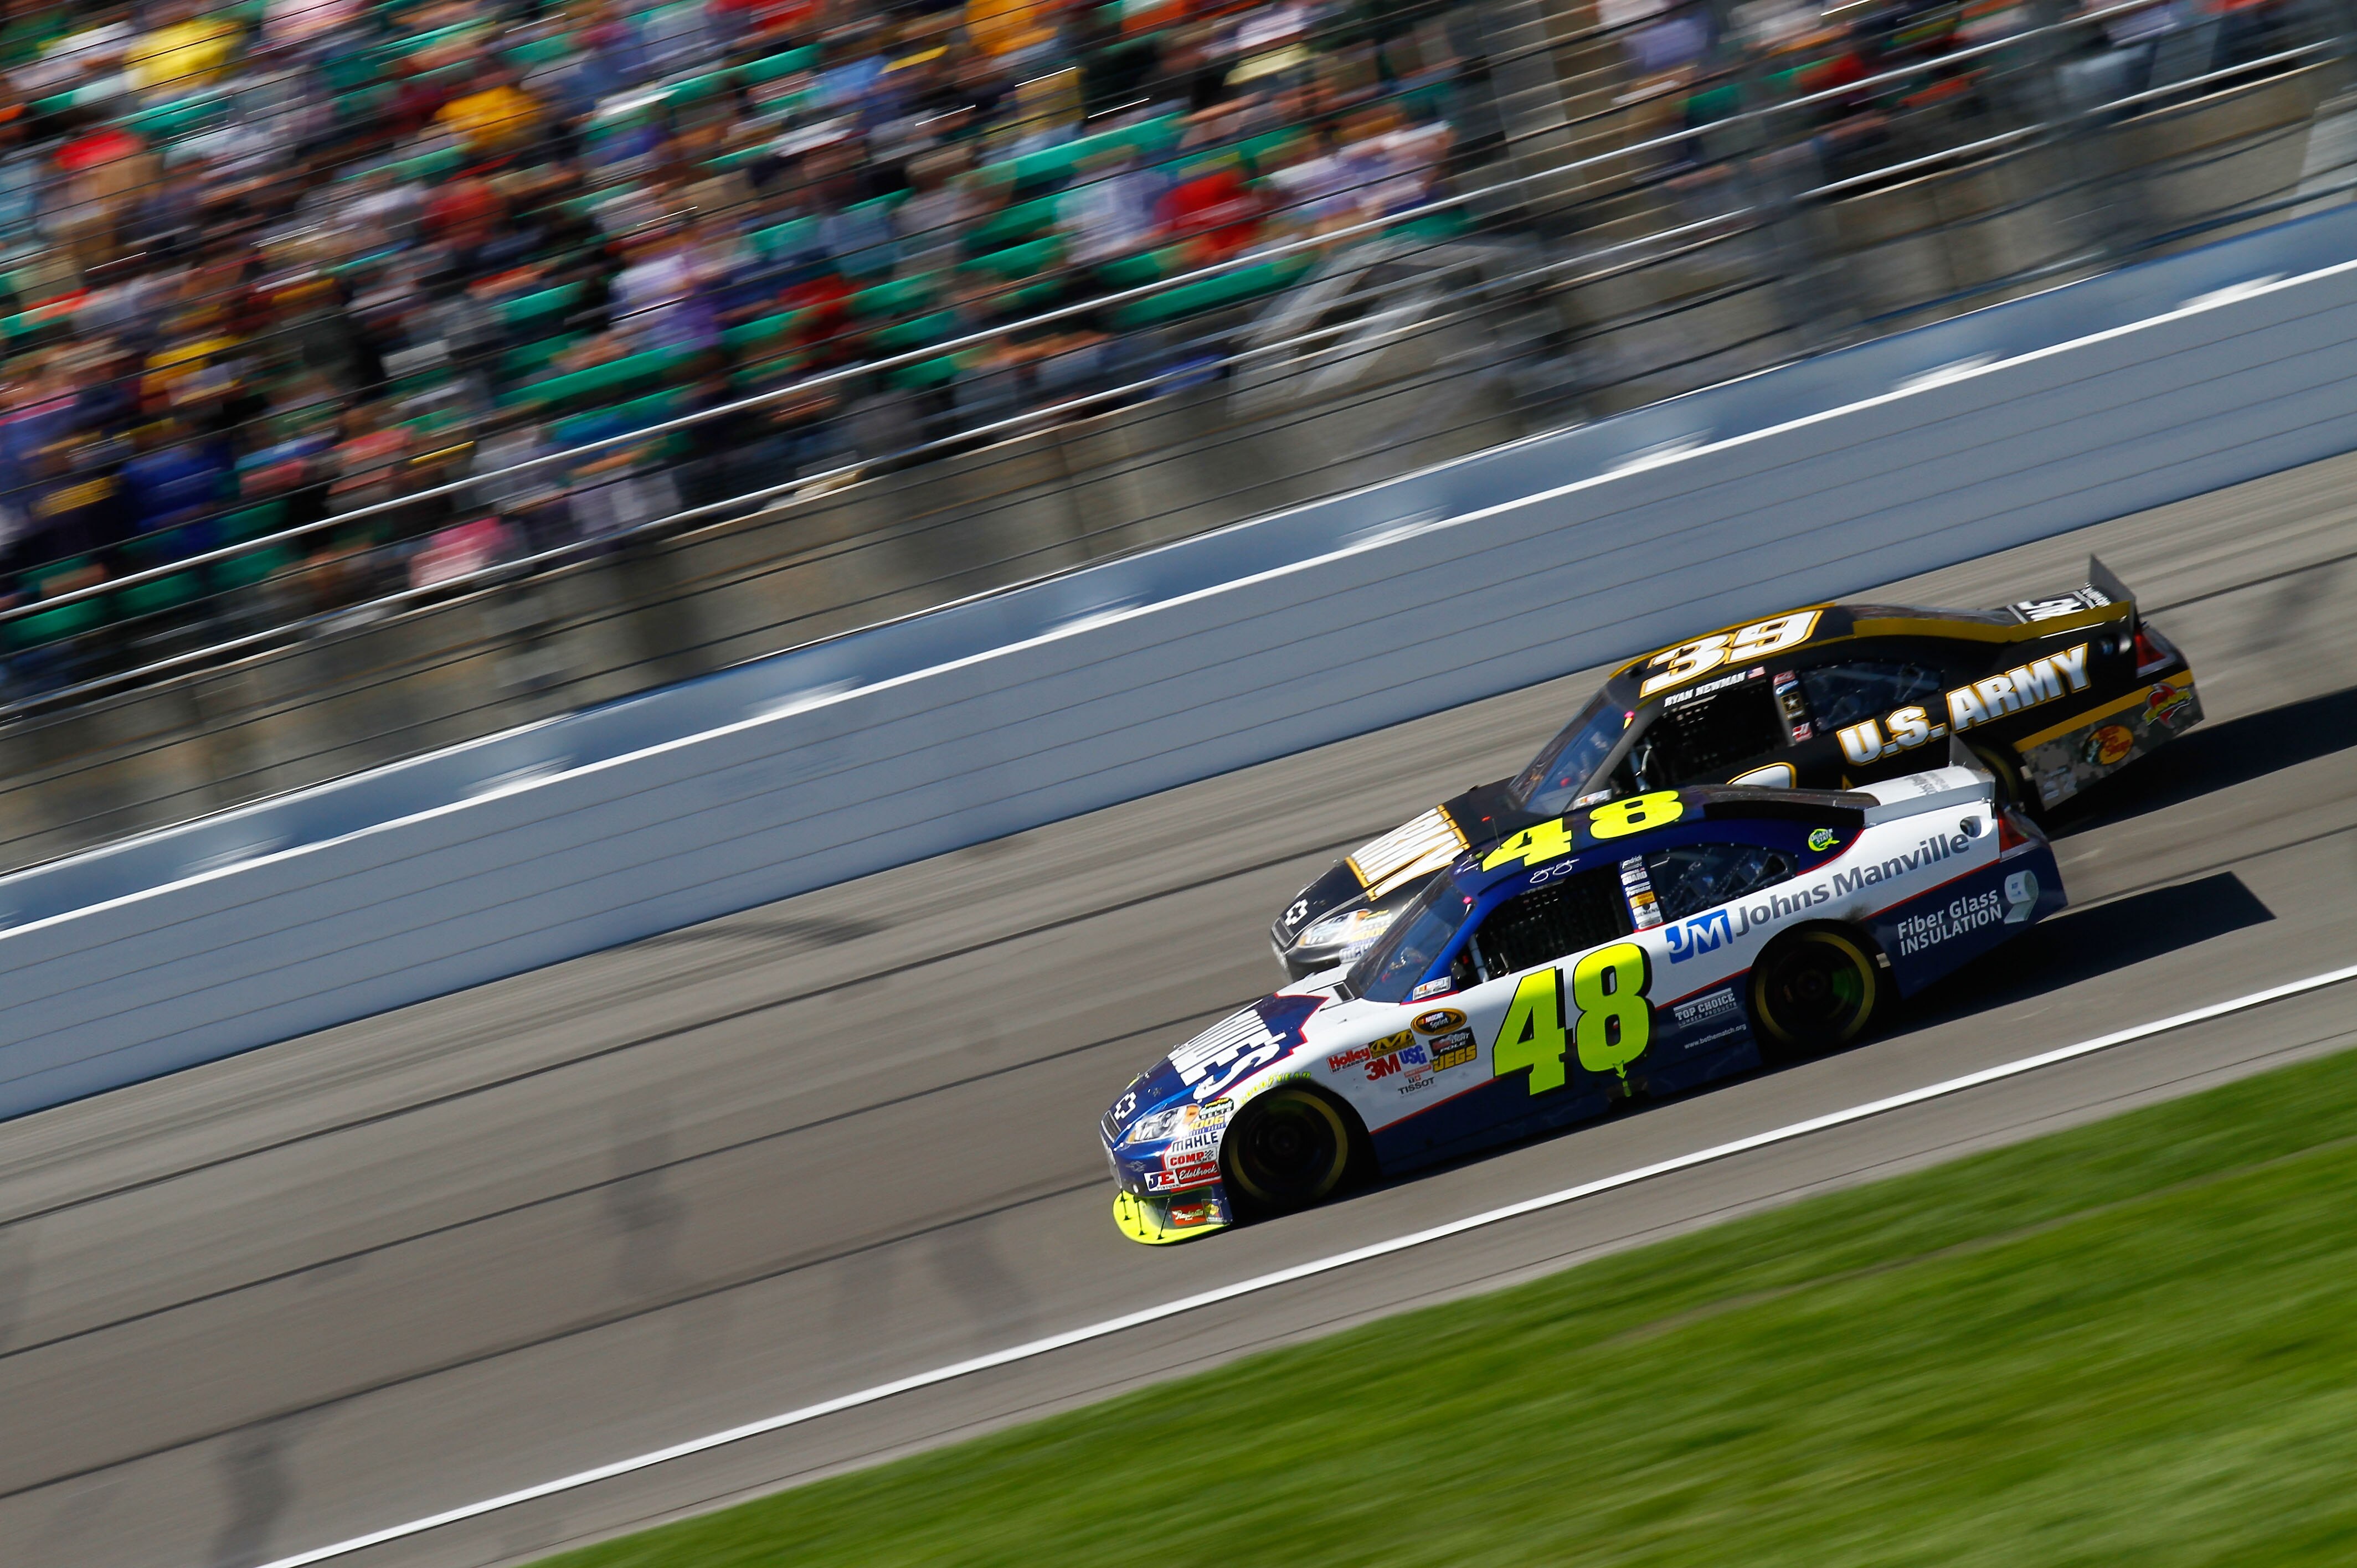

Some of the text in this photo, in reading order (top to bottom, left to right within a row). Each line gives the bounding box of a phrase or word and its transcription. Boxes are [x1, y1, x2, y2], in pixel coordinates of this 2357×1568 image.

[1640, 610, 1824, 698] 39
[1664, 689, 1694, 708] RYAN
[1695, 671, 1747, 697] NEWMAN
[1836, 705, 1949, 766] U.S.
[1946, 643, 2091, 733] ARMY
[1482, 790, 1684, 872] 48
[1736, 834, 1969, 937] Johns Manville
[1898, 889, 1998, 940] Fiber Glass
[1665, 909, 1733, 964] JM
[1900, 904, 2003, 956] INSULATION
[1493, 942, 1652, 1096] 48
[1675, 993, 1735, 1020] TOP CHOICE
[1430, 1018, 1449, 1029] Sprint
[1684, 1023, 1747, 1049] www.bethematch.org
[1329, 1047, 1371, 1069] Holley
[1399, 1045, 1427, 1064] USG
[1433, 1045, 1477, 1072] JEGS
[1440, 1041, 1466, 1052] POLE
[1364, 1053, 1402, 1081] 3M
[1398, 1076, 1434, 1095] TISSOT
[1172, 1131, 1218, 1152] MAHLE
[1170, 1152, 1205, 1166] COMP
[1179, 1165, 1218, 1180] Edelbrock
[1149, 1171, 1175, 1189] JE
